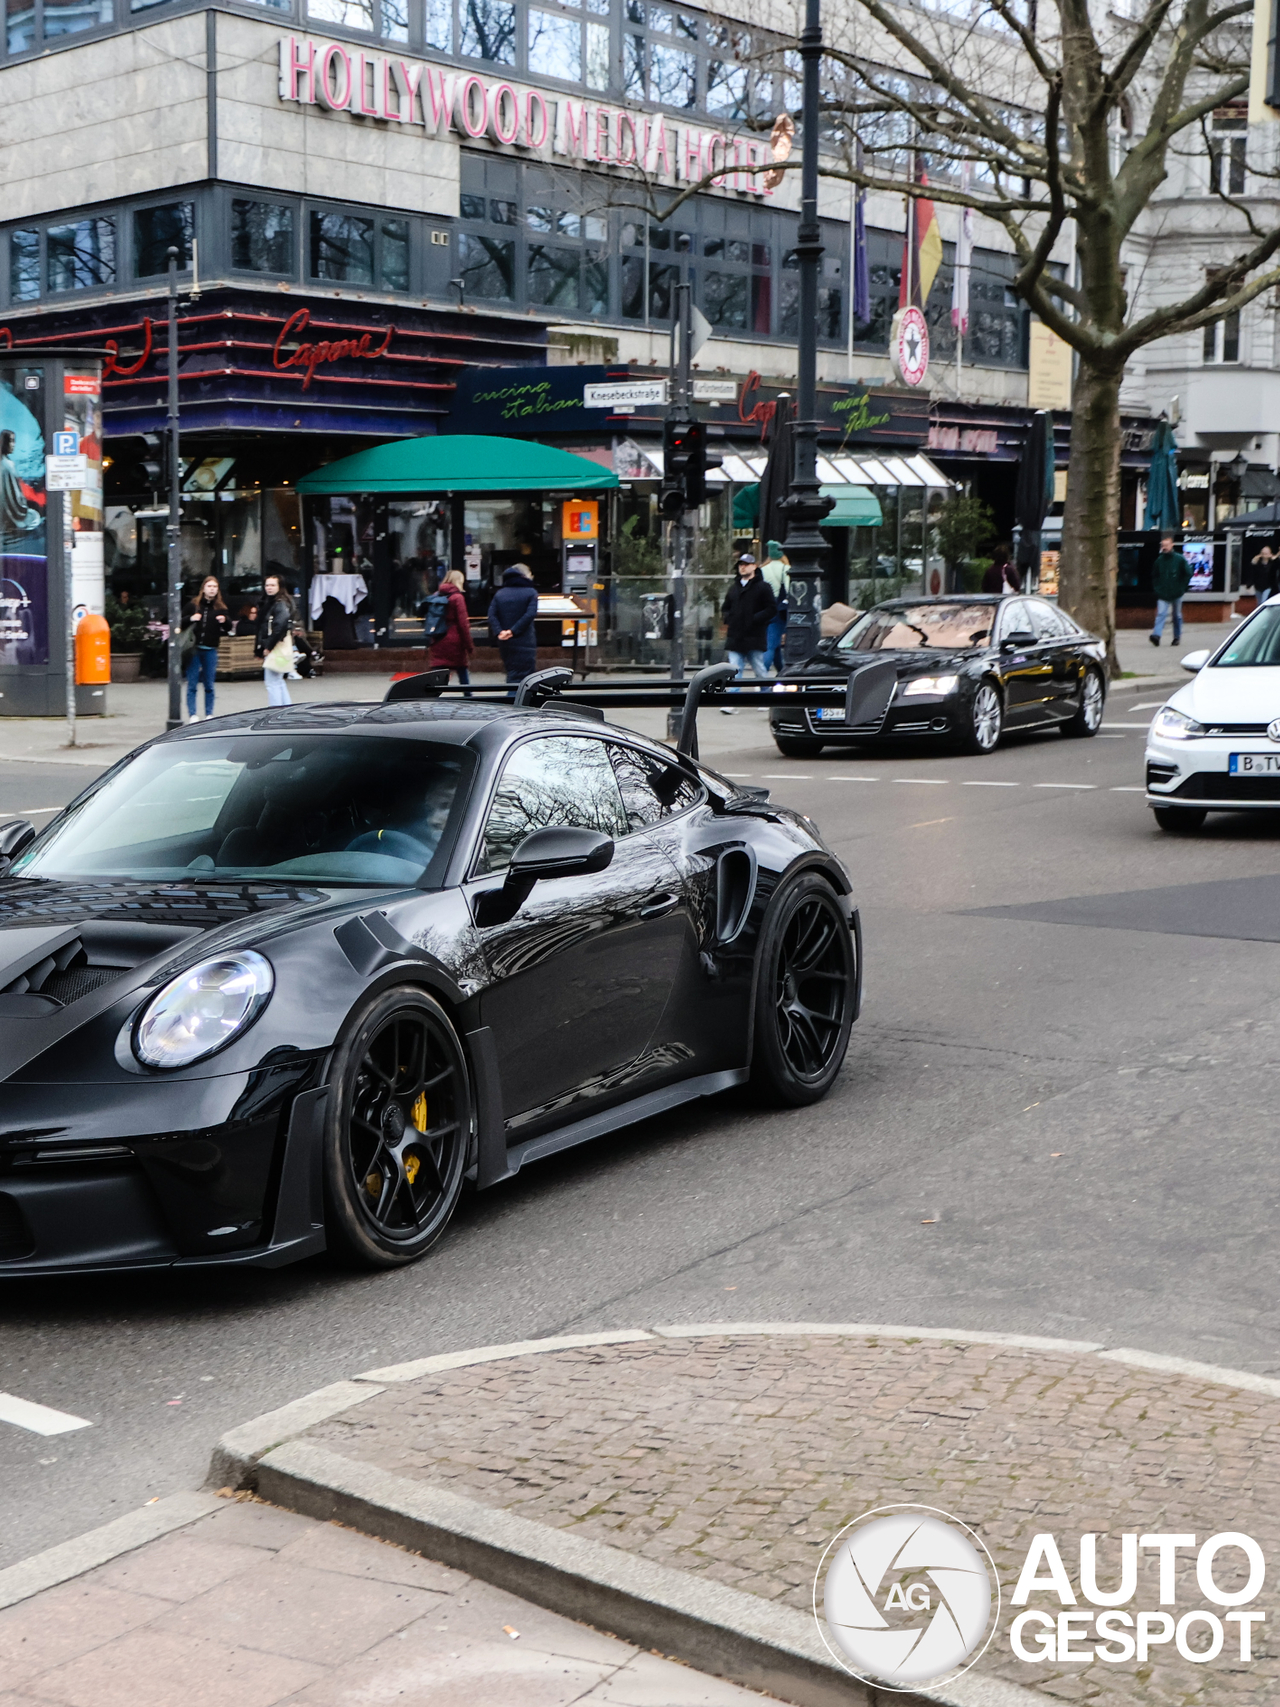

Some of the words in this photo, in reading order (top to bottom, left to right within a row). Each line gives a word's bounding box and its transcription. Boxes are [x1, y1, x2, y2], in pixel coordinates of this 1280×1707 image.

[279, 34, 548, 149] HOLLYWOOD
[554, 99, 669, 176] MEDIA
[674, 127, 773, 196] HOTEL
[273, 308, 395, 391] Capone
[501, 396, 584, 419] italian
[59, 434, 74, 454] P
[1243, 756, 1254, 771] B
